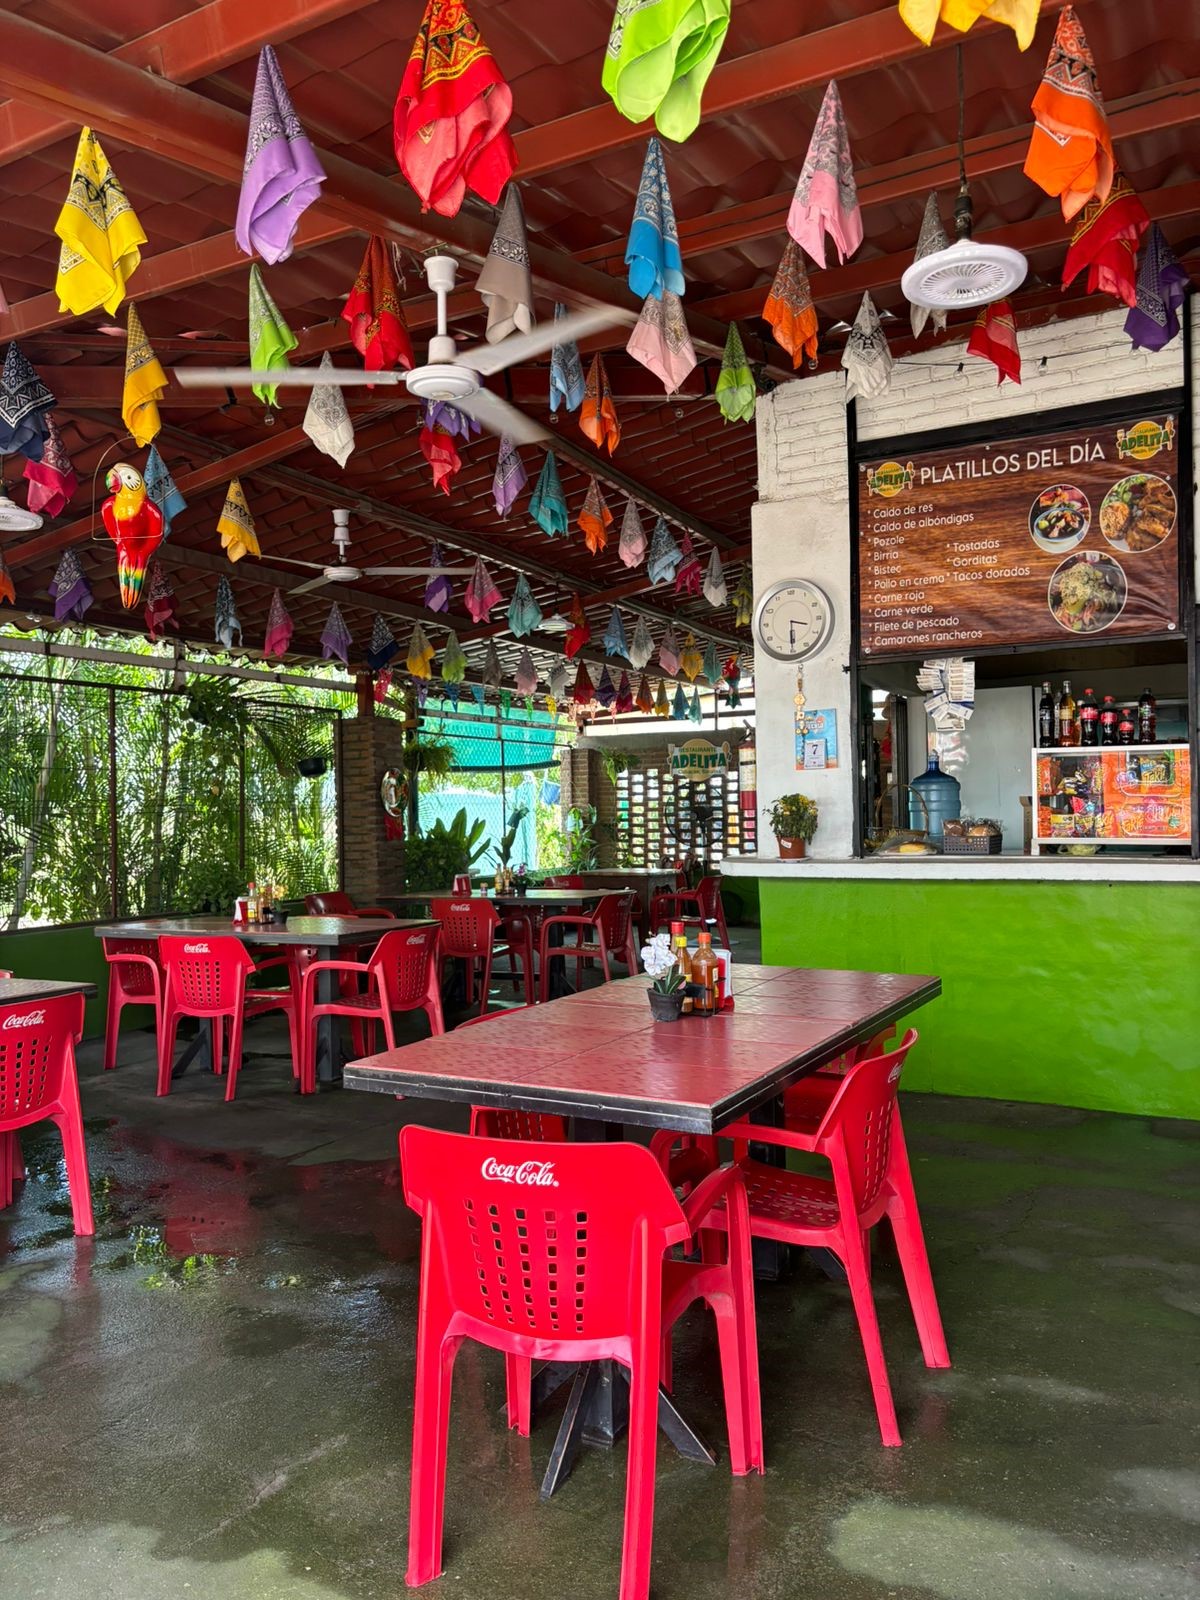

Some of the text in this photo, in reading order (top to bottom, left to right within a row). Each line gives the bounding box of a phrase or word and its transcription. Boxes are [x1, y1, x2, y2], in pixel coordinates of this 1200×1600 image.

[1121, 430, 1169, 451] ADELITA
[921, 438, 1105, 485] PLATILLOS DEL DÍA
[873, 503, 934, 518] Caldo de res
[873, 513, 974, 532] Caldo de albóndigas
[873, 535, 905, 547] Pozole
[952, 539, 1000, 552] Tostadas
[873, 551, 899, 561] Birria
[952, 555, 998, 567] Gorditas
[874, 565, 901, 575] Bistec
[952, 566, 1031, 581] Tacos dorados
[874, 575, 945, 589] Pollo en crema
[874, 590, 925, 603] Carne roja
[874, 604, 934, 618] Carne verde
[874, 616, 960, 632] Filete de pescado
[874, 629, 983, 646] Camarones rancheros
[811, 744, 818, 755] 7
[672, 753, 727, 769] ADELITA
